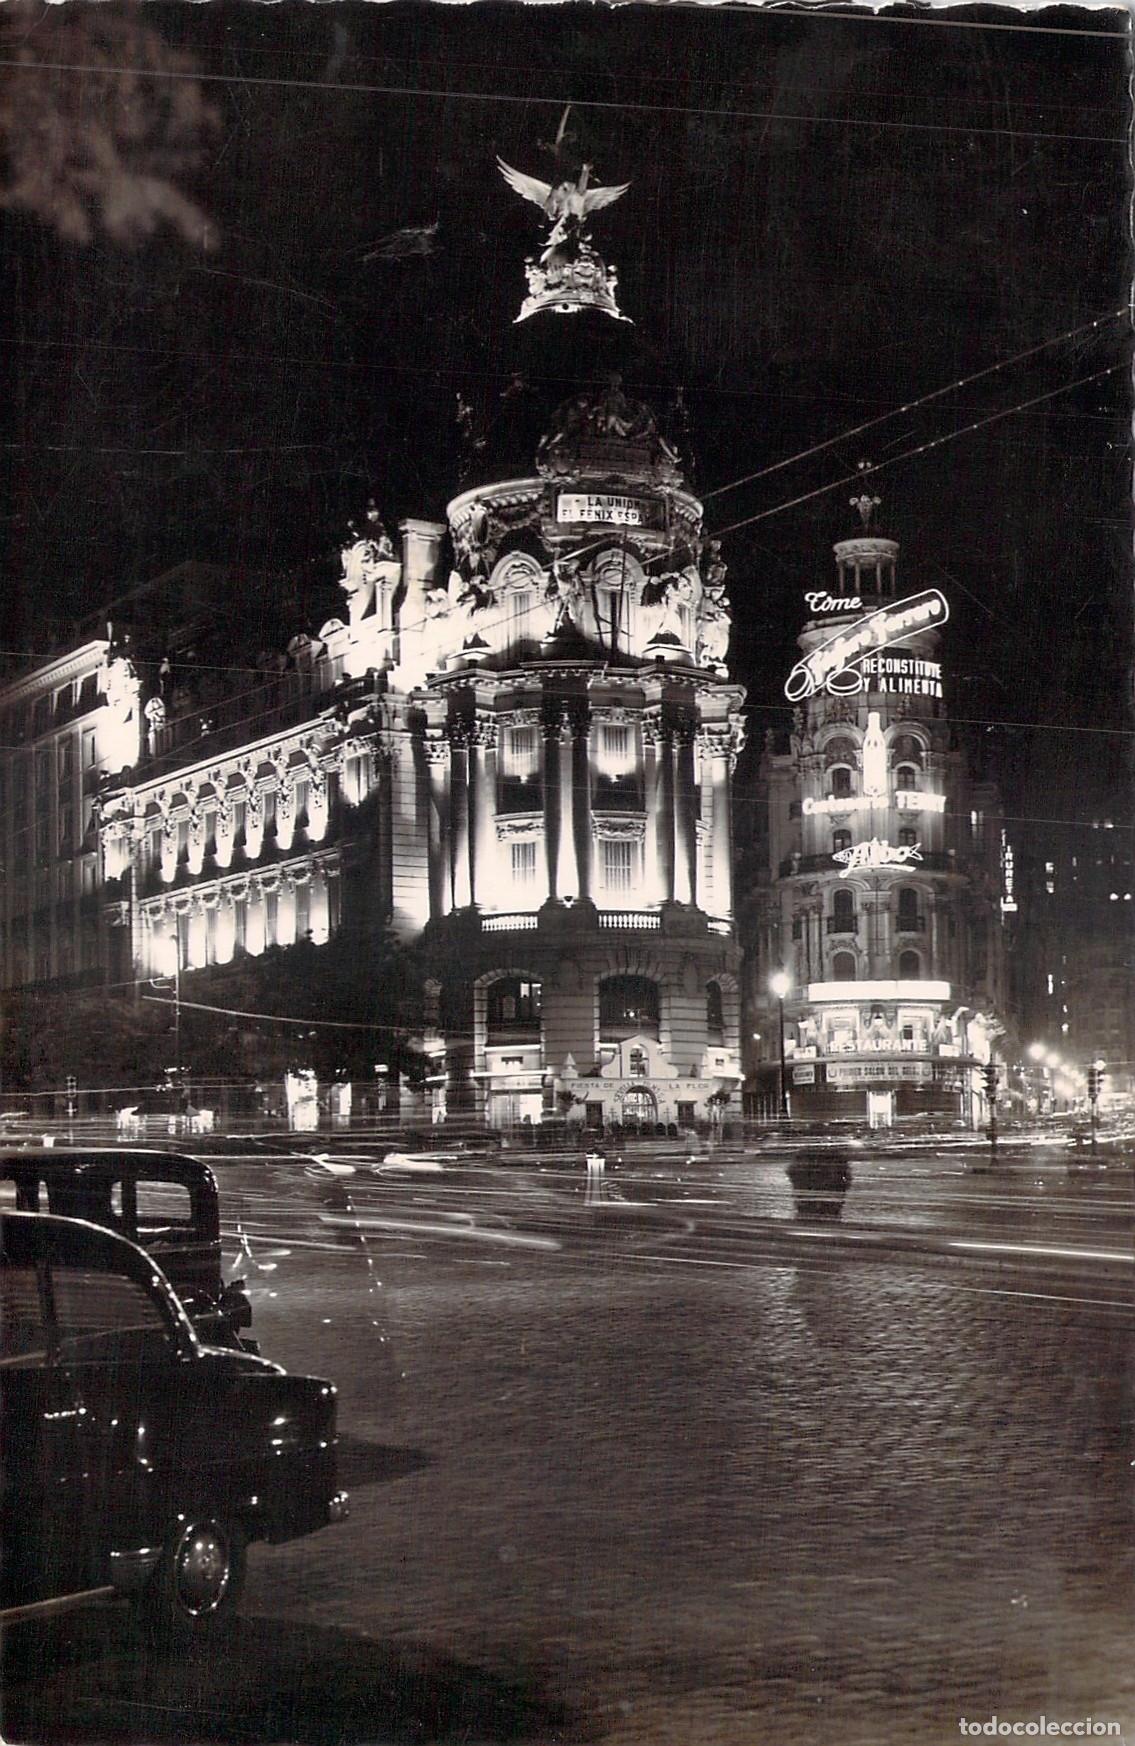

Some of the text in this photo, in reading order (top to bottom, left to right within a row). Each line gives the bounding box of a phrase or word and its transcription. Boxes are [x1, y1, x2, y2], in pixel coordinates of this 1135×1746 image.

[587, 496, 602, 506] LA
[580, 509, 613, 520] FENIX
[804, 591, 863, 612] Come
[862, 678, 943, 698] Y ALIMENTA
[829, 1038, 929, 1052] RESTAURANTE
